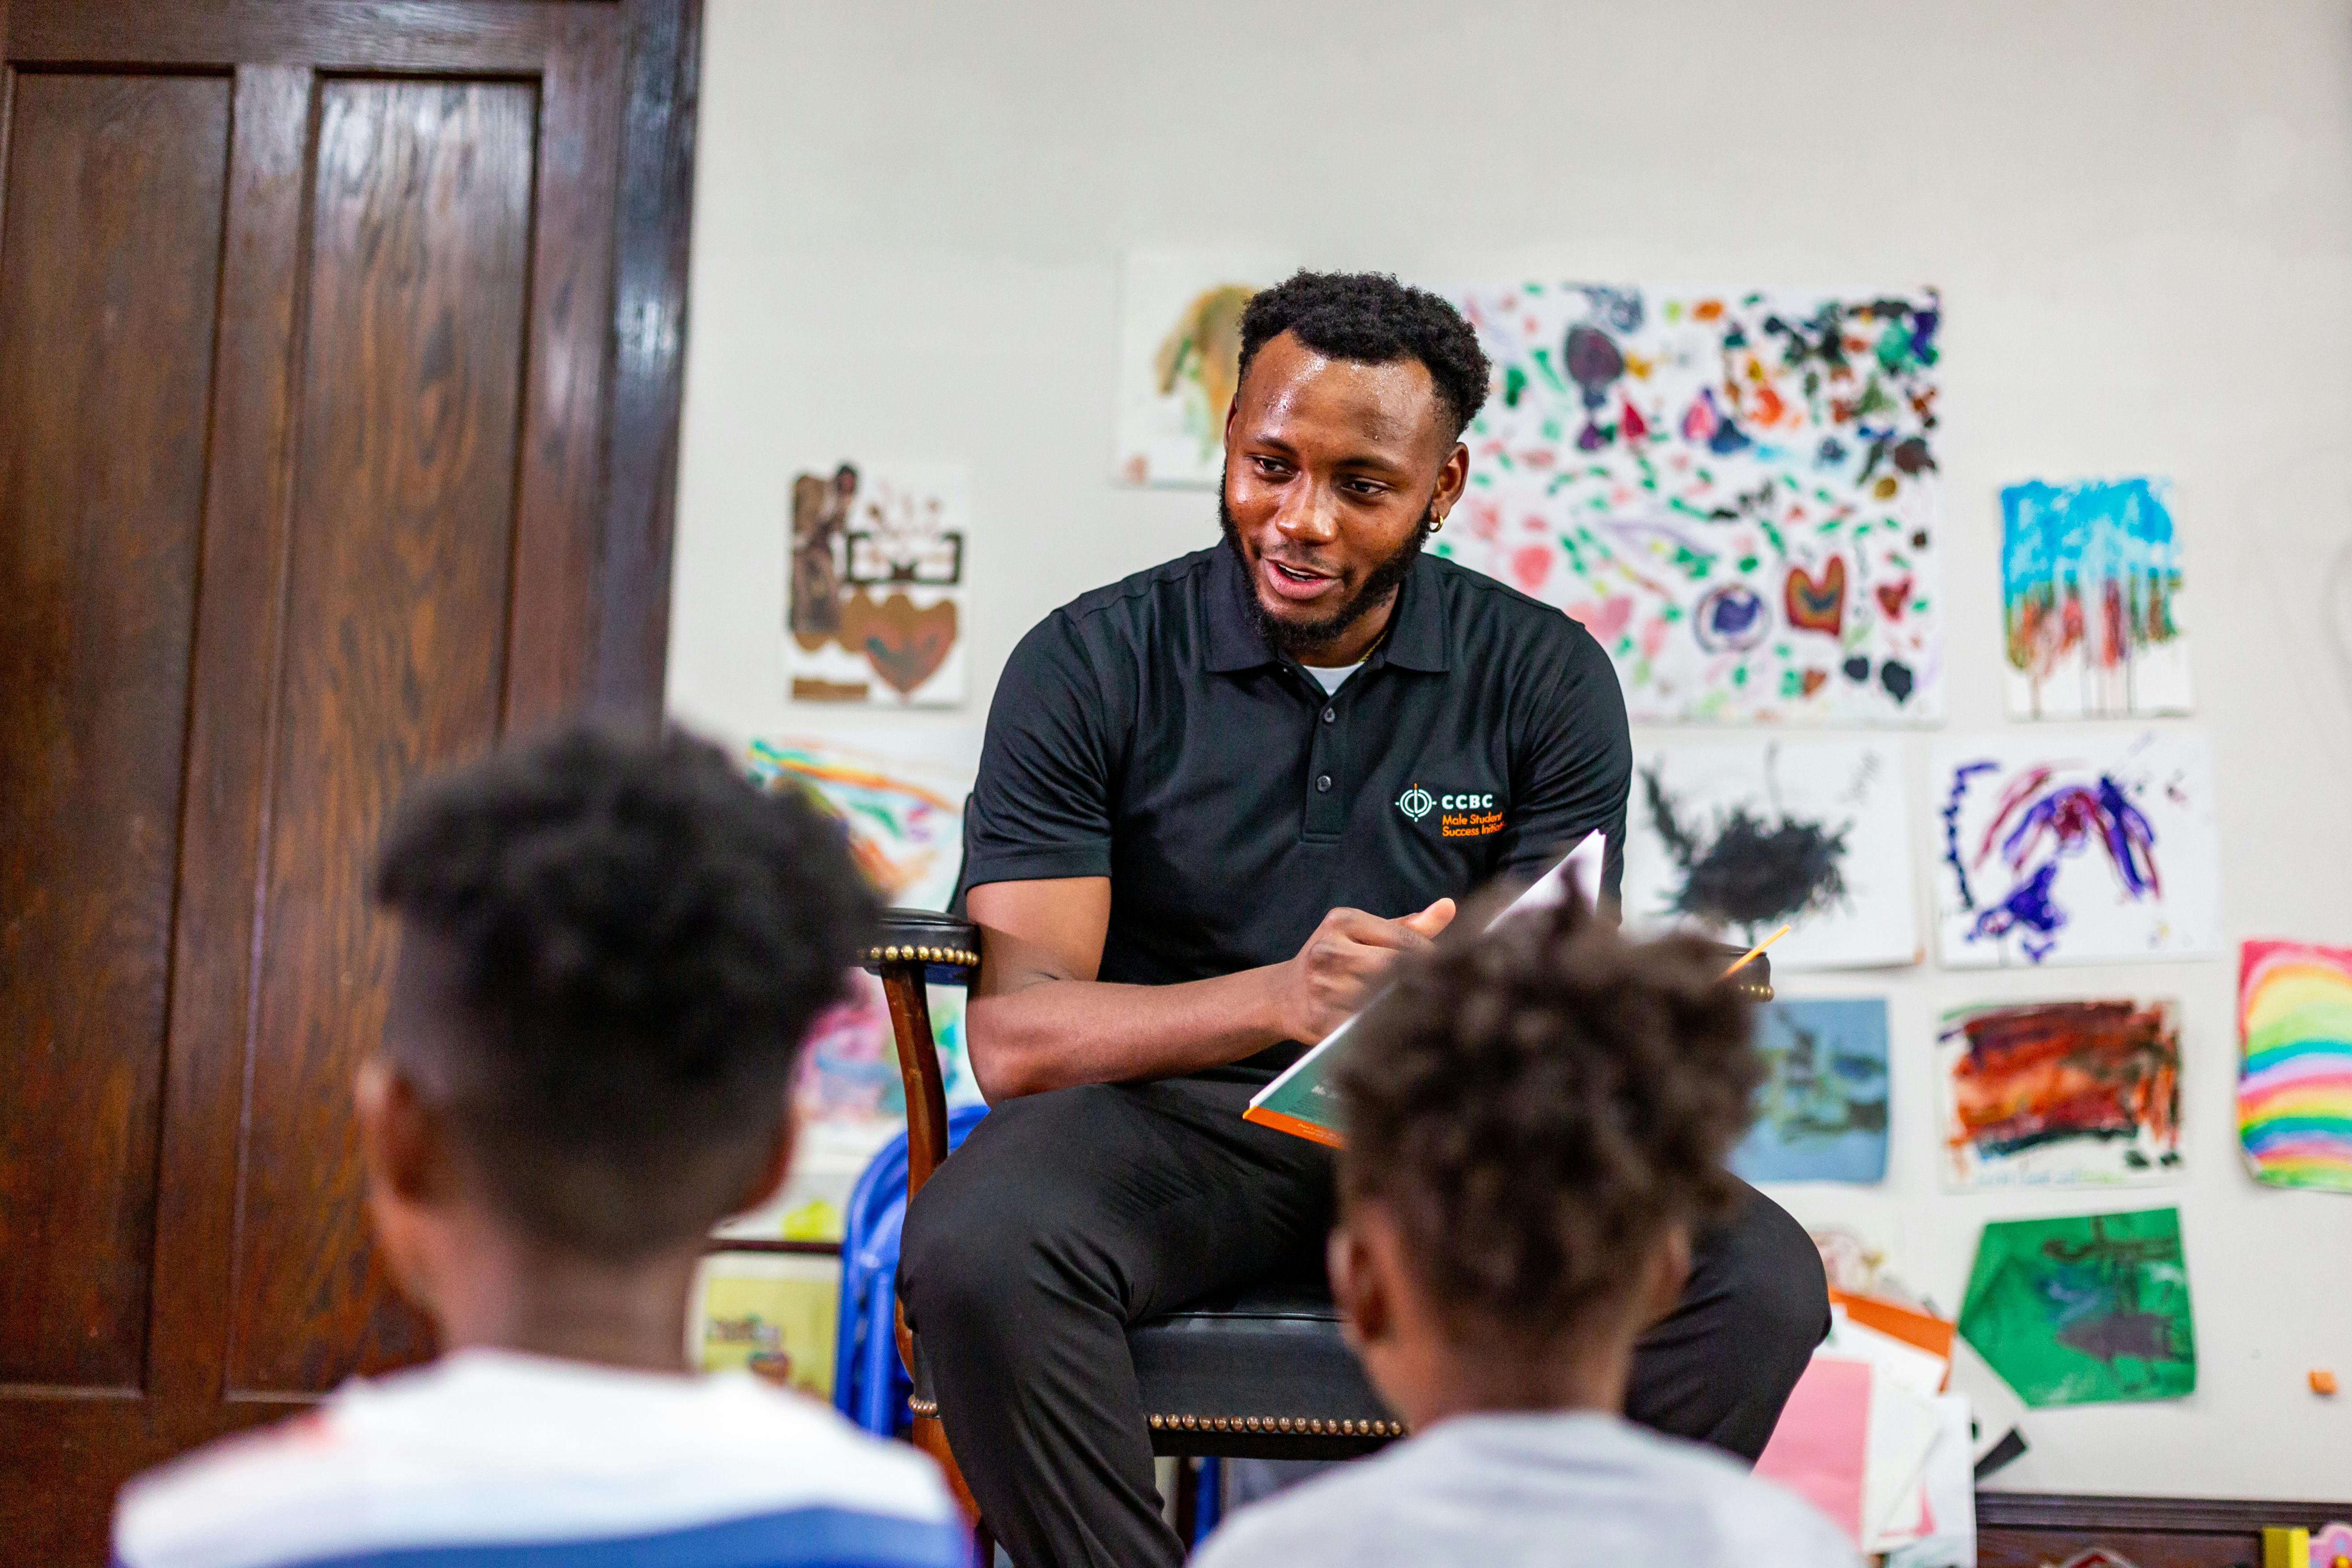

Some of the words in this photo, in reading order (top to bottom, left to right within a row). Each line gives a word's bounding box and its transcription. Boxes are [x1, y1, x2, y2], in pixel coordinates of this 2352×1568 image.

[1441, 794, 1493, 810] CCBC
[1442, 812, 1468, 826] Male
[1469, 811, 1503, 825] Student
[1442, 825, 1480, 837] Success
